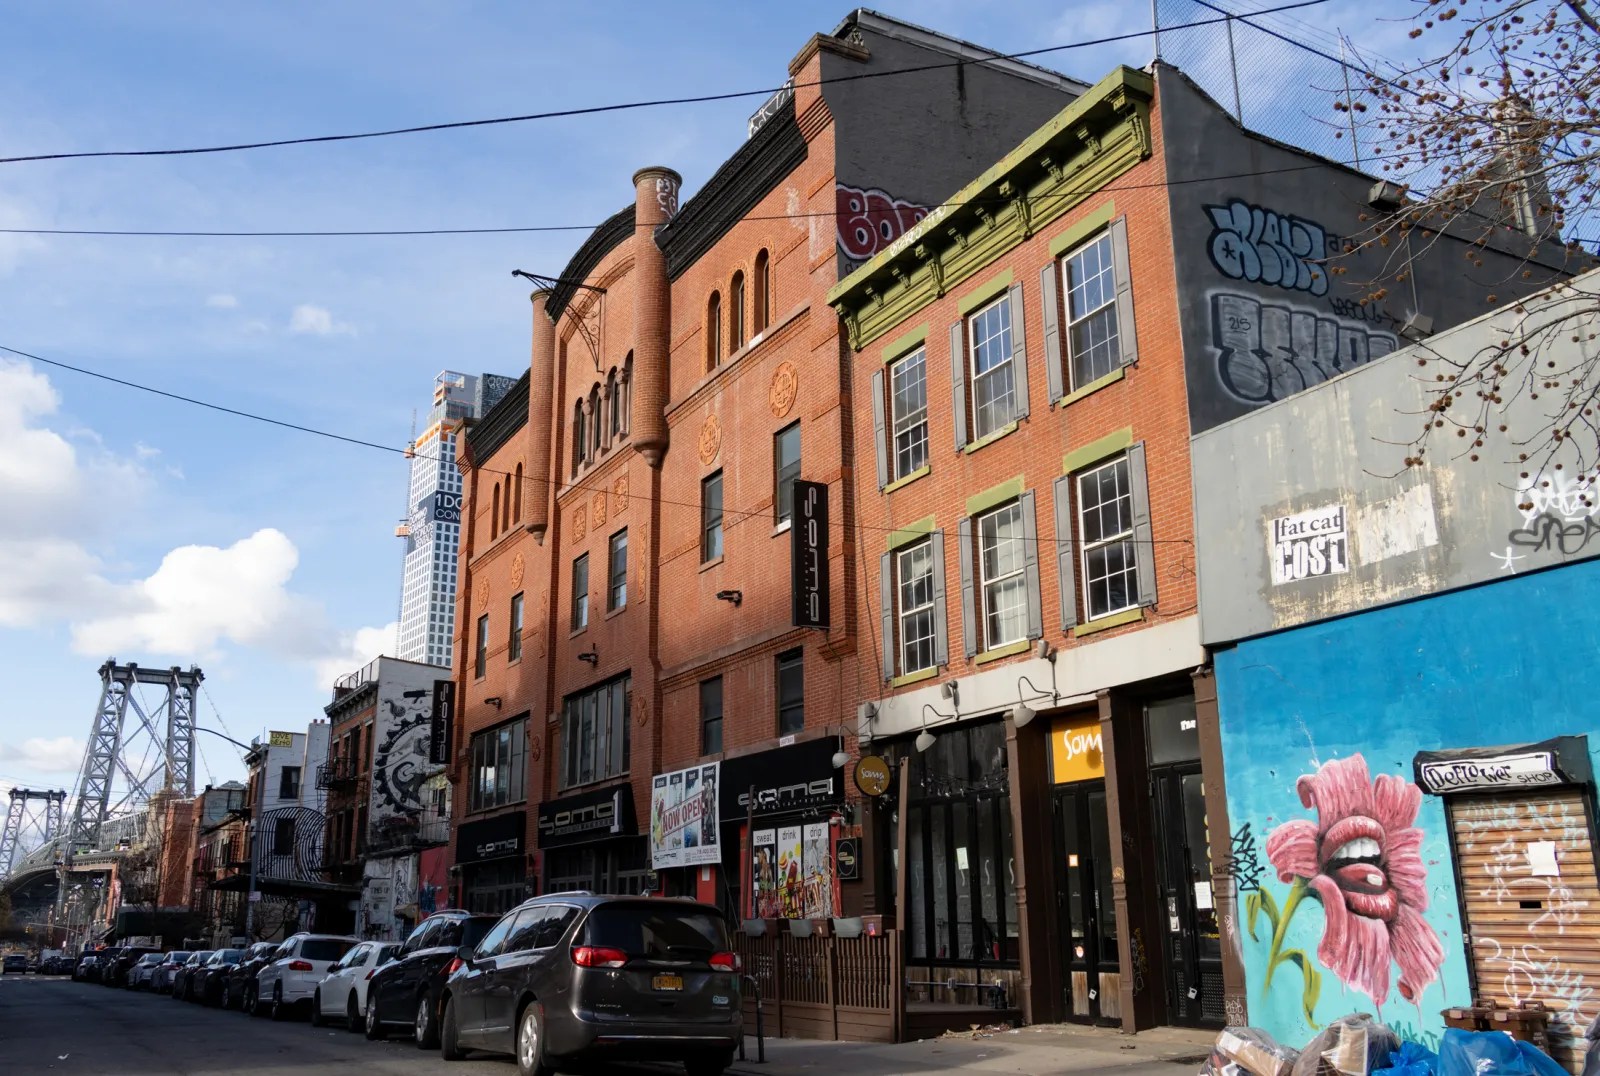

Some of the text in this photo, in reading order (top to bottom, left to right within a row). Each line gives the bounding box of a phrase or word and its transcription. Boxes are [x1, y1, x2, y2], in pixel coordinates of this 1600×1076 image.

[444, 494, 463, 511] DO
[435, 508, 461, 521] CON
[1280, 513, 1342, 537] fat cat
[1274, 534, 1345, 582] COST
[1063, 729, 1103, 761] Som
[1517, 772, 1553, 784] SHOP
[662, 796, 703, 832] NOW OPEN
[756, 833, 772, 844] sweat
[782, 829, 797, 841] drink
[809, 826, 822, 838] drip
